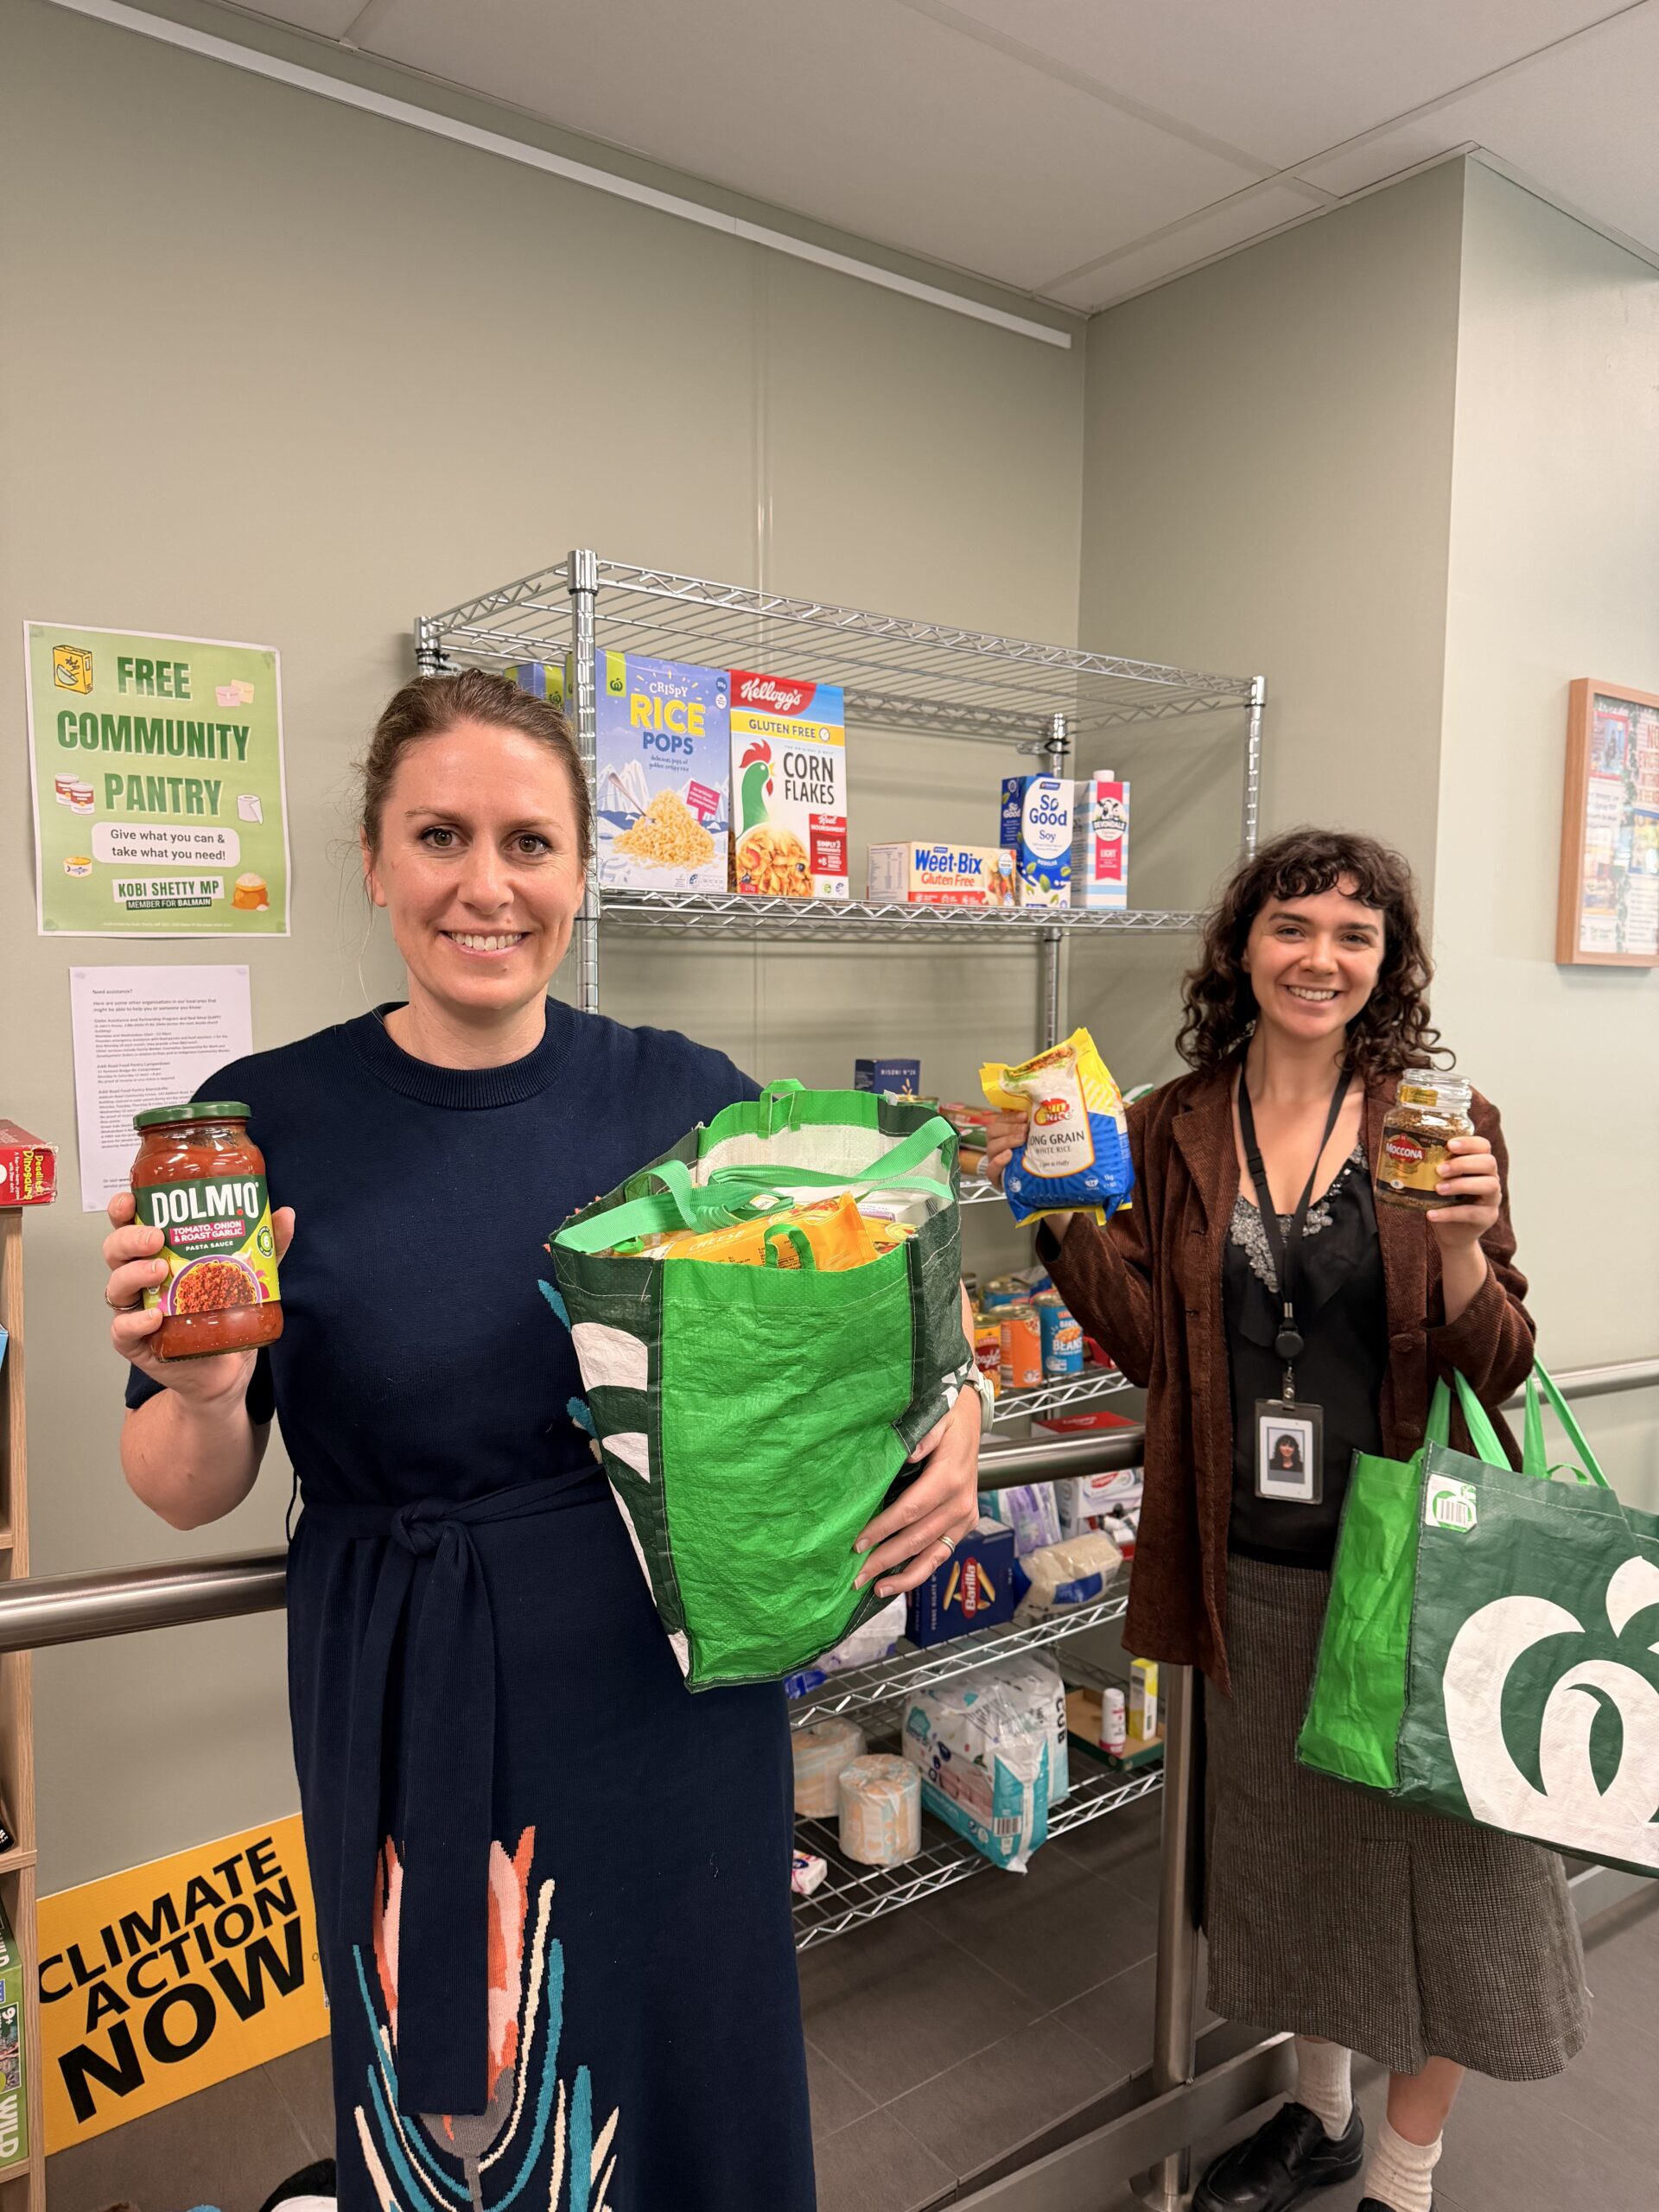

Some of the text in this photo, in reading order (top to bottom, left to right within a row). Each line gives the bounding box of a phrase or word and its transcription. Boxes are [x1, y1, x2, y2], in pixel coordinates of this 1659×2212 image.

[117, 656, 192, 699] FREE
[649, 681, 688, 697] CRISPY
[741, 677, 802, 711] Kellogg's
[630, 692, 705, 737] RICE
[56, 710, 250, 761] COMMUNITY
[749, 719, 816, 739] GLUTEN FREE
[643, 731, 694, 755] POPS
[783, 752, 834, 783] CORN
[104, 772, 222, 816] PANTRY
[785, 779, 835, 805] FLAKES
[1039, 794, 1058, 811] So
[1029, 808, 1067, 826] Good
[111, 829, 226, 844] Give what you can &
[1039, 830, 1056, 842] Soy
[111, 847, 226, 861] take what you need!
[118, 880, 219, 898] KOBI SHETTY MP
[921, 873, 975, 887] Gluten Free
[128, 900, 161, 909] MEMBER
[1029, 1131, 1084, 1146] ONG GRAIN
[1386, 1142, 1423, 1159] MOCCONA
[22, 1150, 34, 1200] Dinosaurs
[173, 1221, 242, 1236] TOMATO, ONION
[181, 1231, 211, 1243] ROAST
[212, 1228, 243, 1239] GARLIC
[186, 1240, 234, 1252] PASTA SAUCE
[689, 1230, 746, 1251] CHEESE
[965, 1565, 976, 1611] Barilla
[38, 1837, 283, 2004] CLIMATE
[86, 1876, 297, 2034] ACTION
[58, 1916, 306, 2124] NOW
